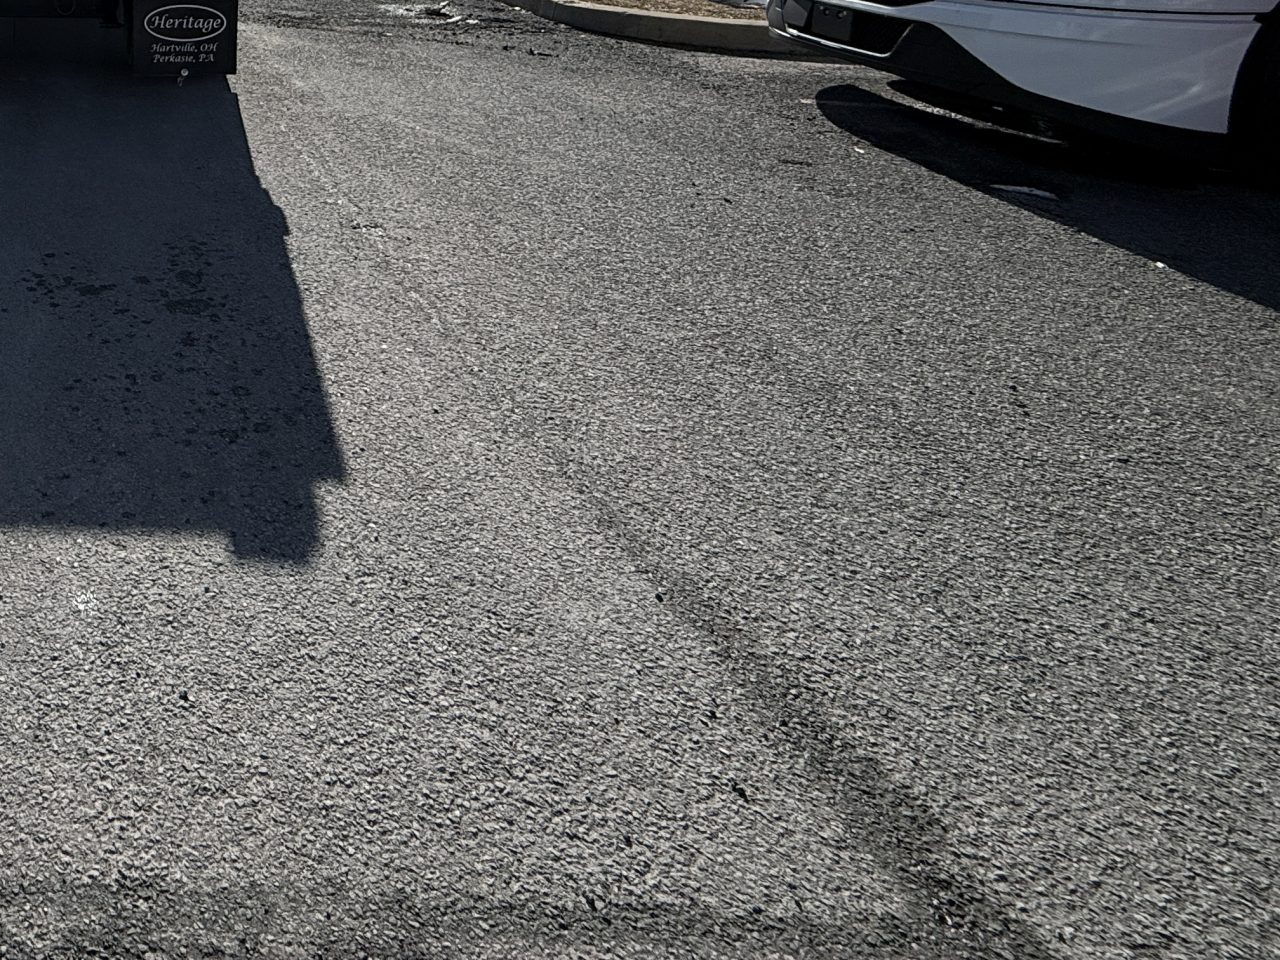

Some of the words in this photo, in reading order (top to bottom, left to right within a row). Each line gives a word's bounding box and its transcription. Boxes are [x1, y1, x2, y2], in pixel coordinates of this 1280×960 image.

[149, 14, 221, 33] Heritage
[150, 42, 198, 53] Hartville,
[200, 42, 219, 52] OH
[198, 53, 215, 62] PA
